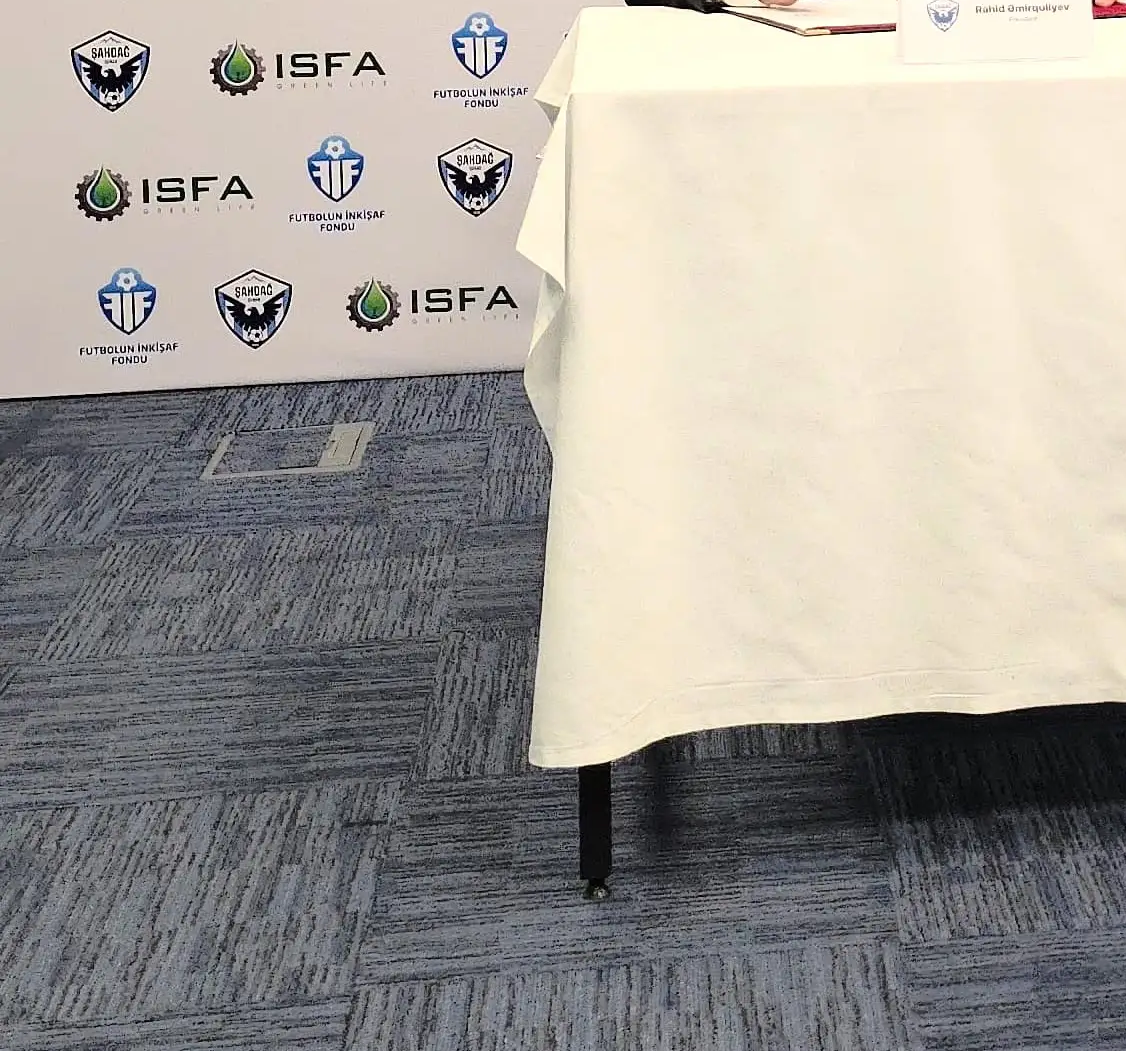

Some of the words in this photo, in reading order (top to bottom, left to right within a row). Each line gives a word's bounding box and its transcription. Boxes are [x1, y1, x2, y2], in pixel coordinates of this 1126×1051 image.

[276, 52, 385, 78] ISFA
[433, 88, 487, 99] FUTBOLUN
[464, 98, 499, 108] FONDU
[143, 176, 253, 203] ISFA
[288, 212, 343, 223] FUTBOLUN
[320, 222, 355, 232] FONDU
[412, 286, 518, 313] ISFA
[79, 344, 135, 356] FUTBOLUN
[111, 355, 148, 365] FONDU
